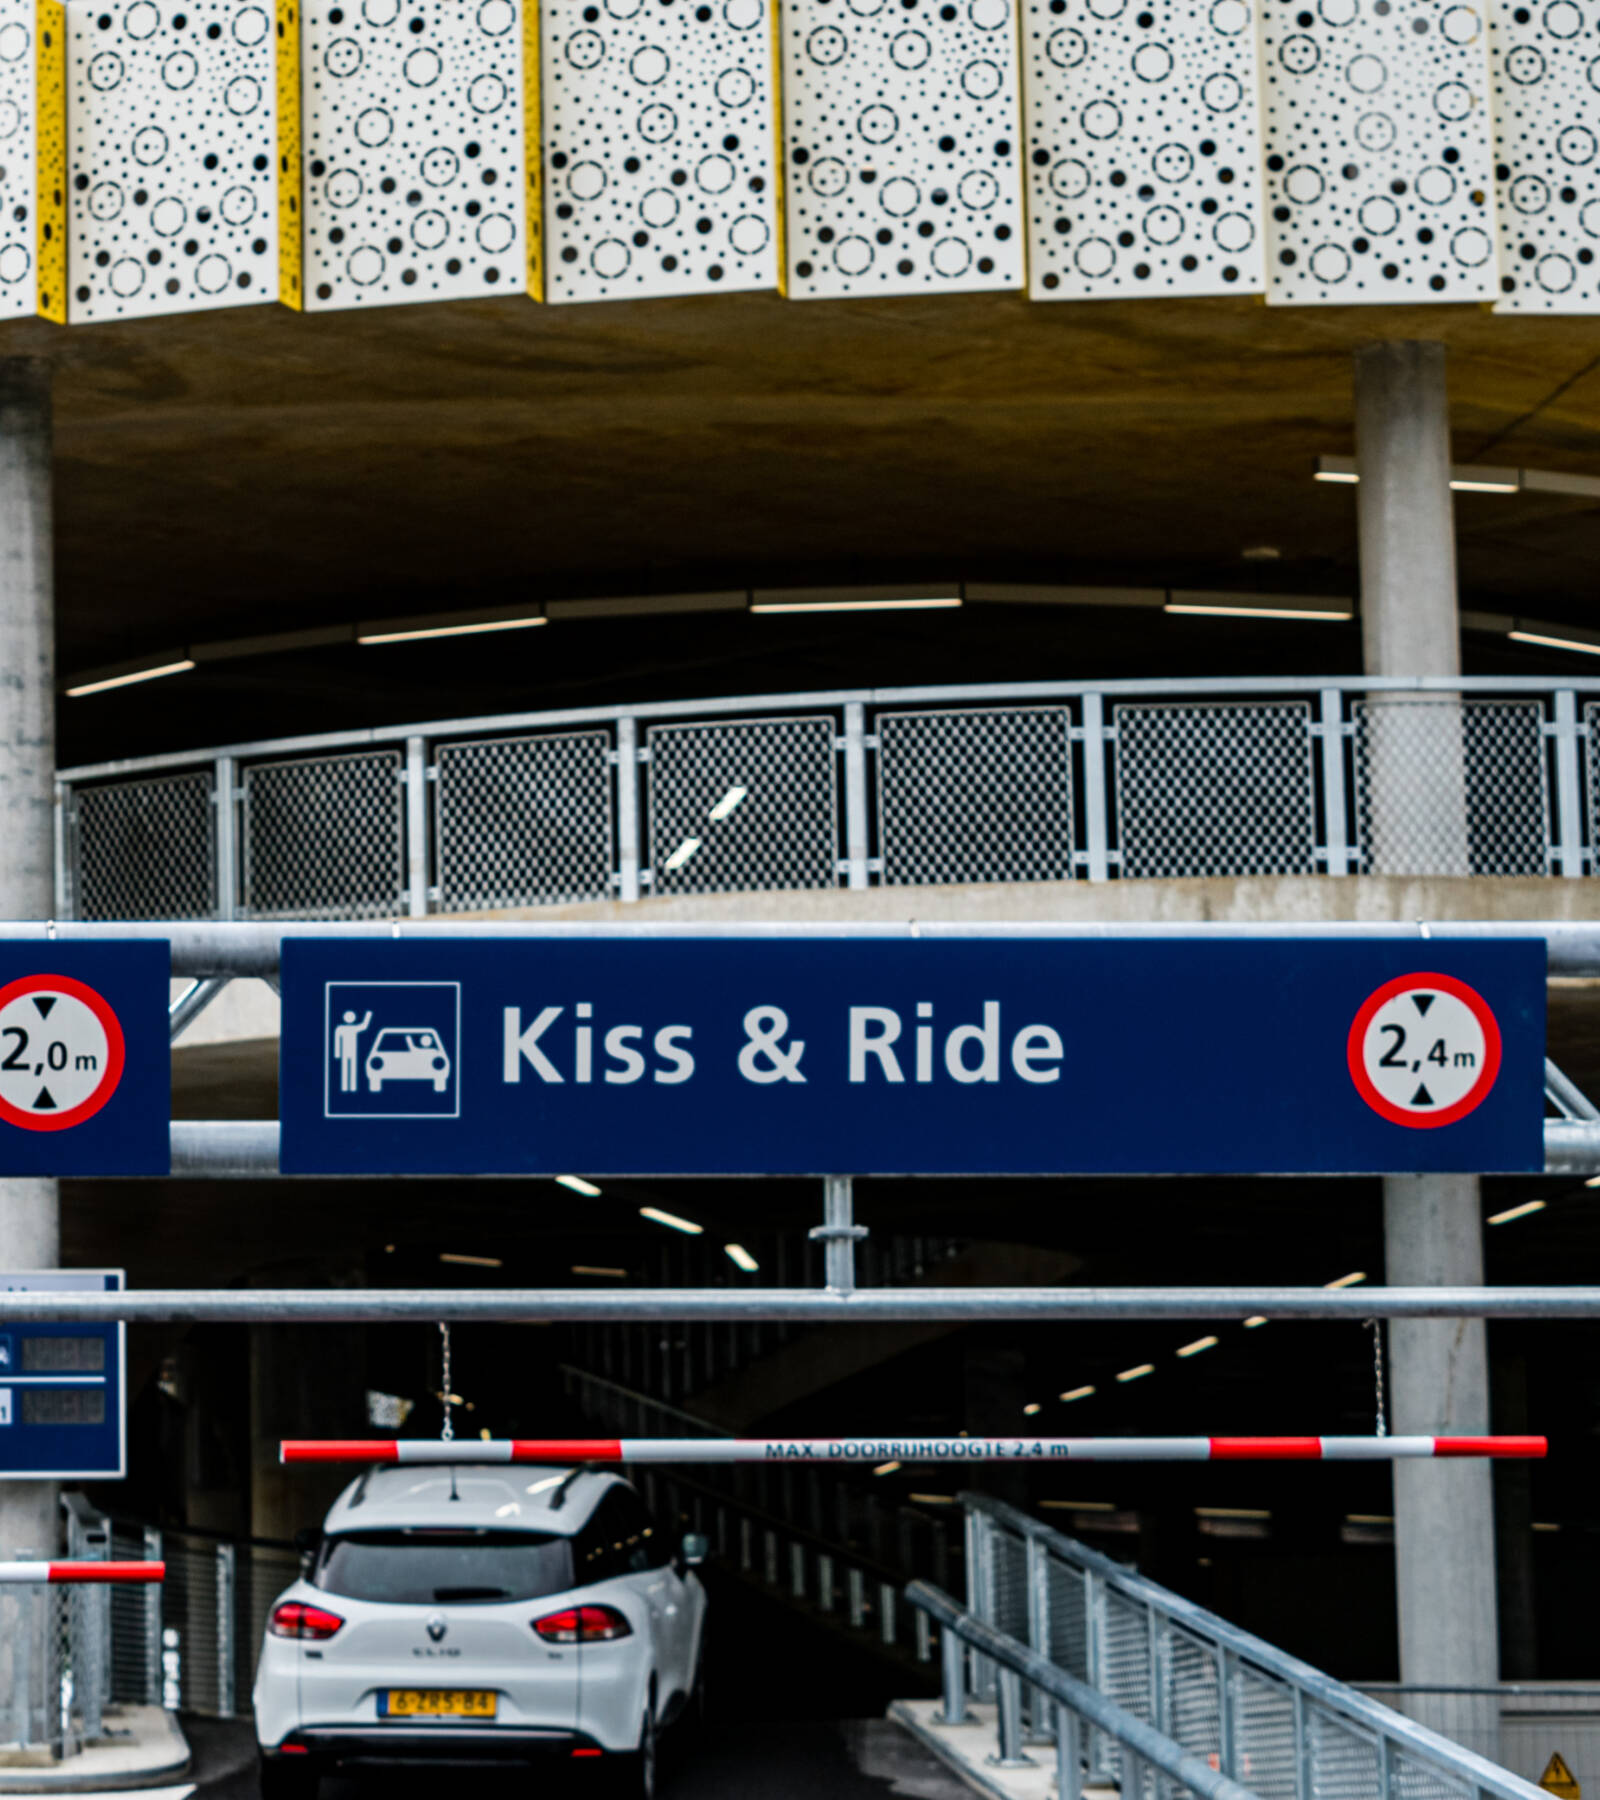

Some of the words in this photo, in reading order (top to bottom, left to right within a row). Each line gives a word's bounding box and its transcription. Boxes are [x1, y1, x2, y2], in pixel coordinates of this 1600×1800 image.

[503, 1002, 696, 1084] Kiss
[736, 1005, 808, 1084] &
[848, 1001, 1065, 1084] Ride
[764, 1443, 821, 1458] MAX.
[1049, 1444, 1070, 1458] m
